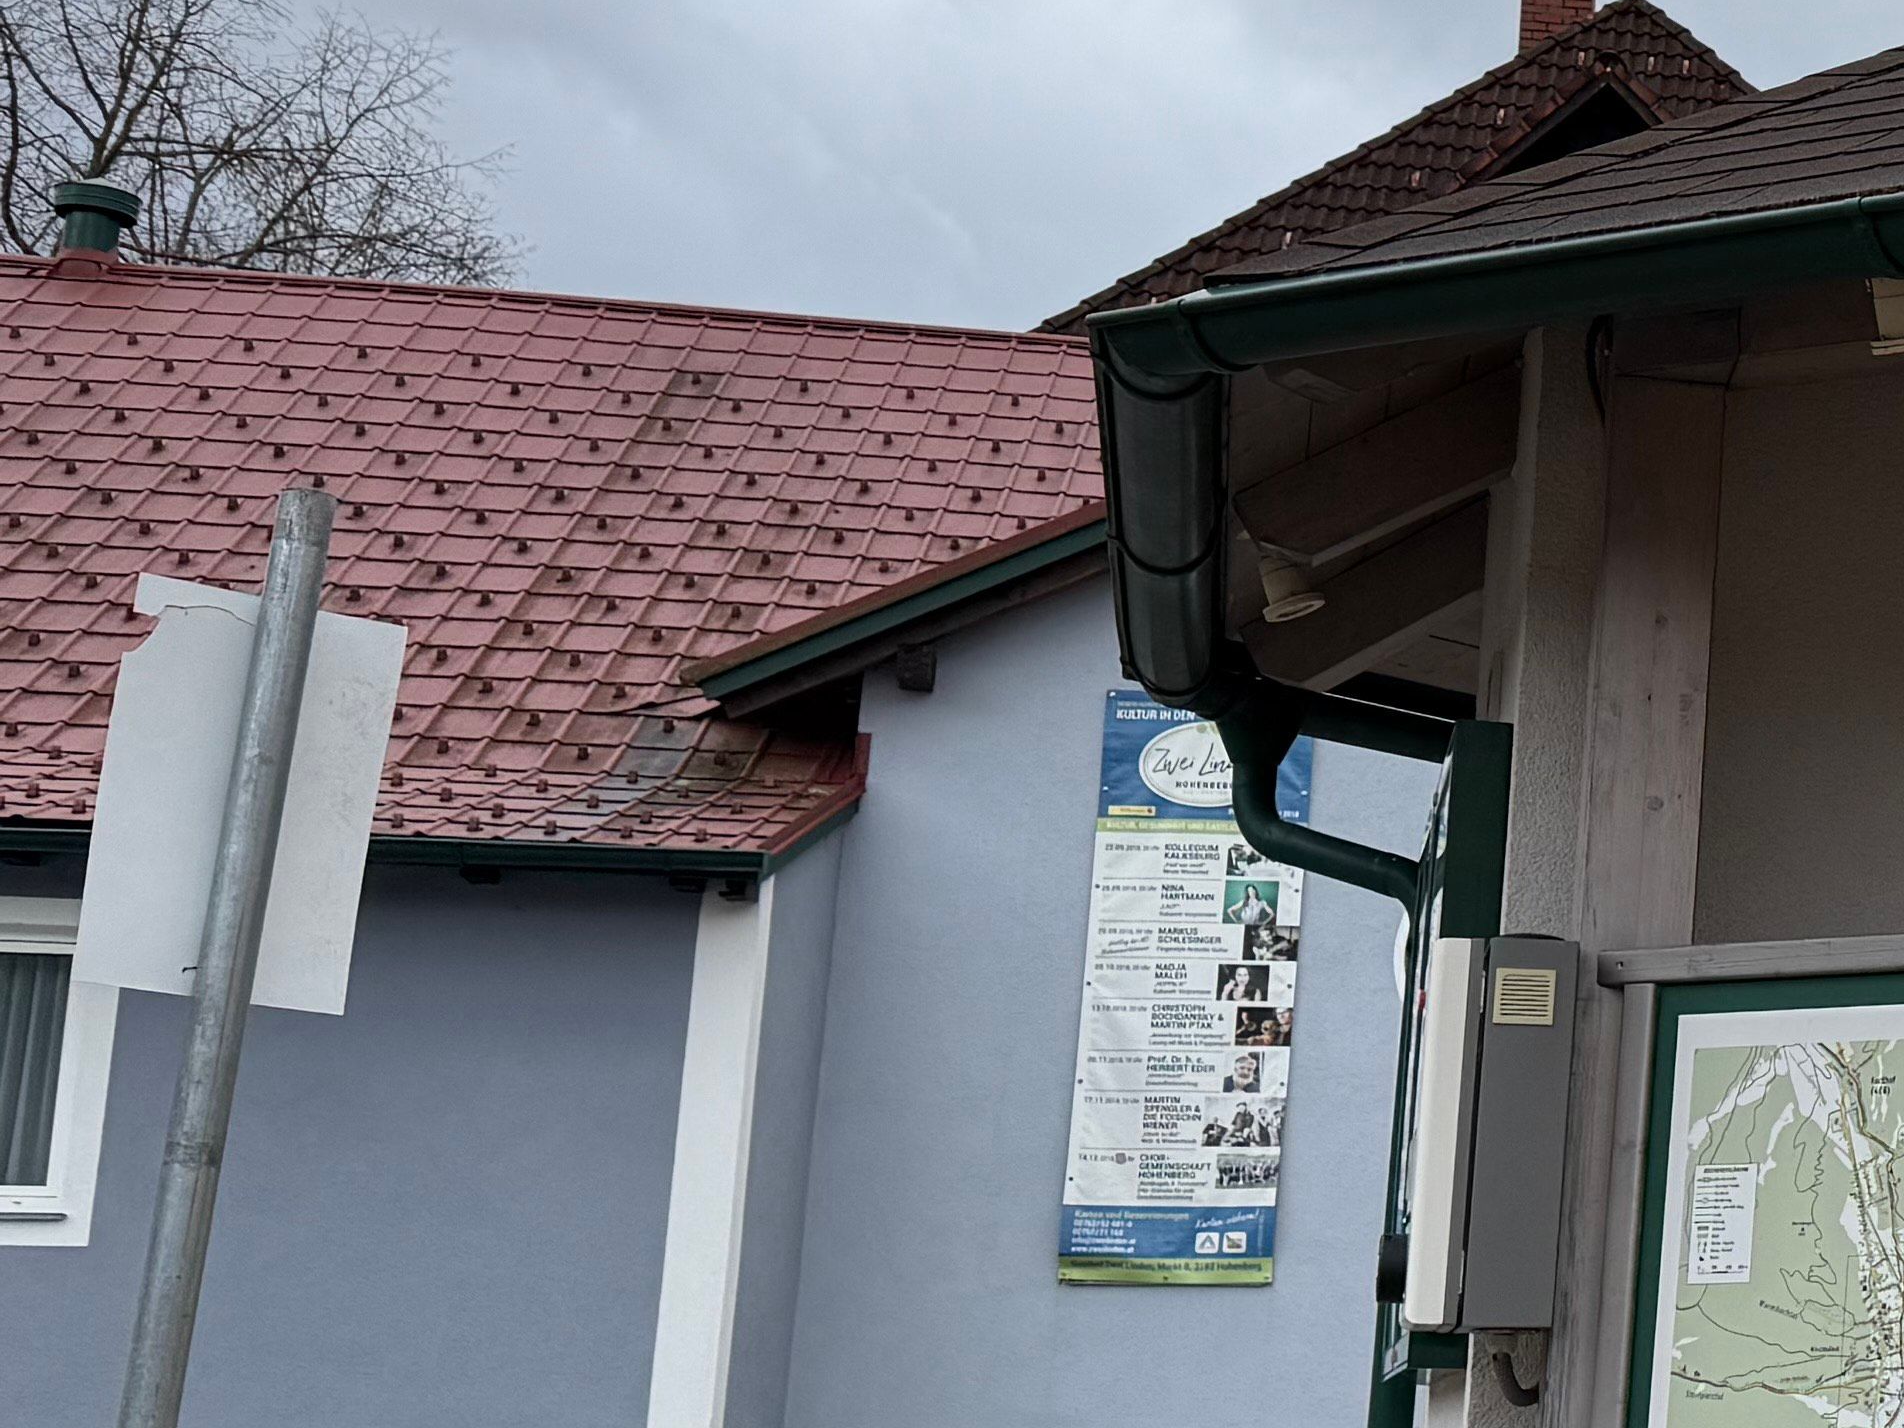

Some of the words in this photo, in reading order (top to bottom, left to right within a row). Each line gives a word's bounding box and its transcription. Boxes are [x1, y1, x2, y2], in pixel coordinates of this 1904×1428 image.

[1116, 709, 1157, 720] KULTUR
[1159, 710, 1171, 720] IN
[1173, 709, 1195, 721] DEN
[1152, 748, 1194, 775] Zwei
[1199, 742, 1233, 776] Lin
